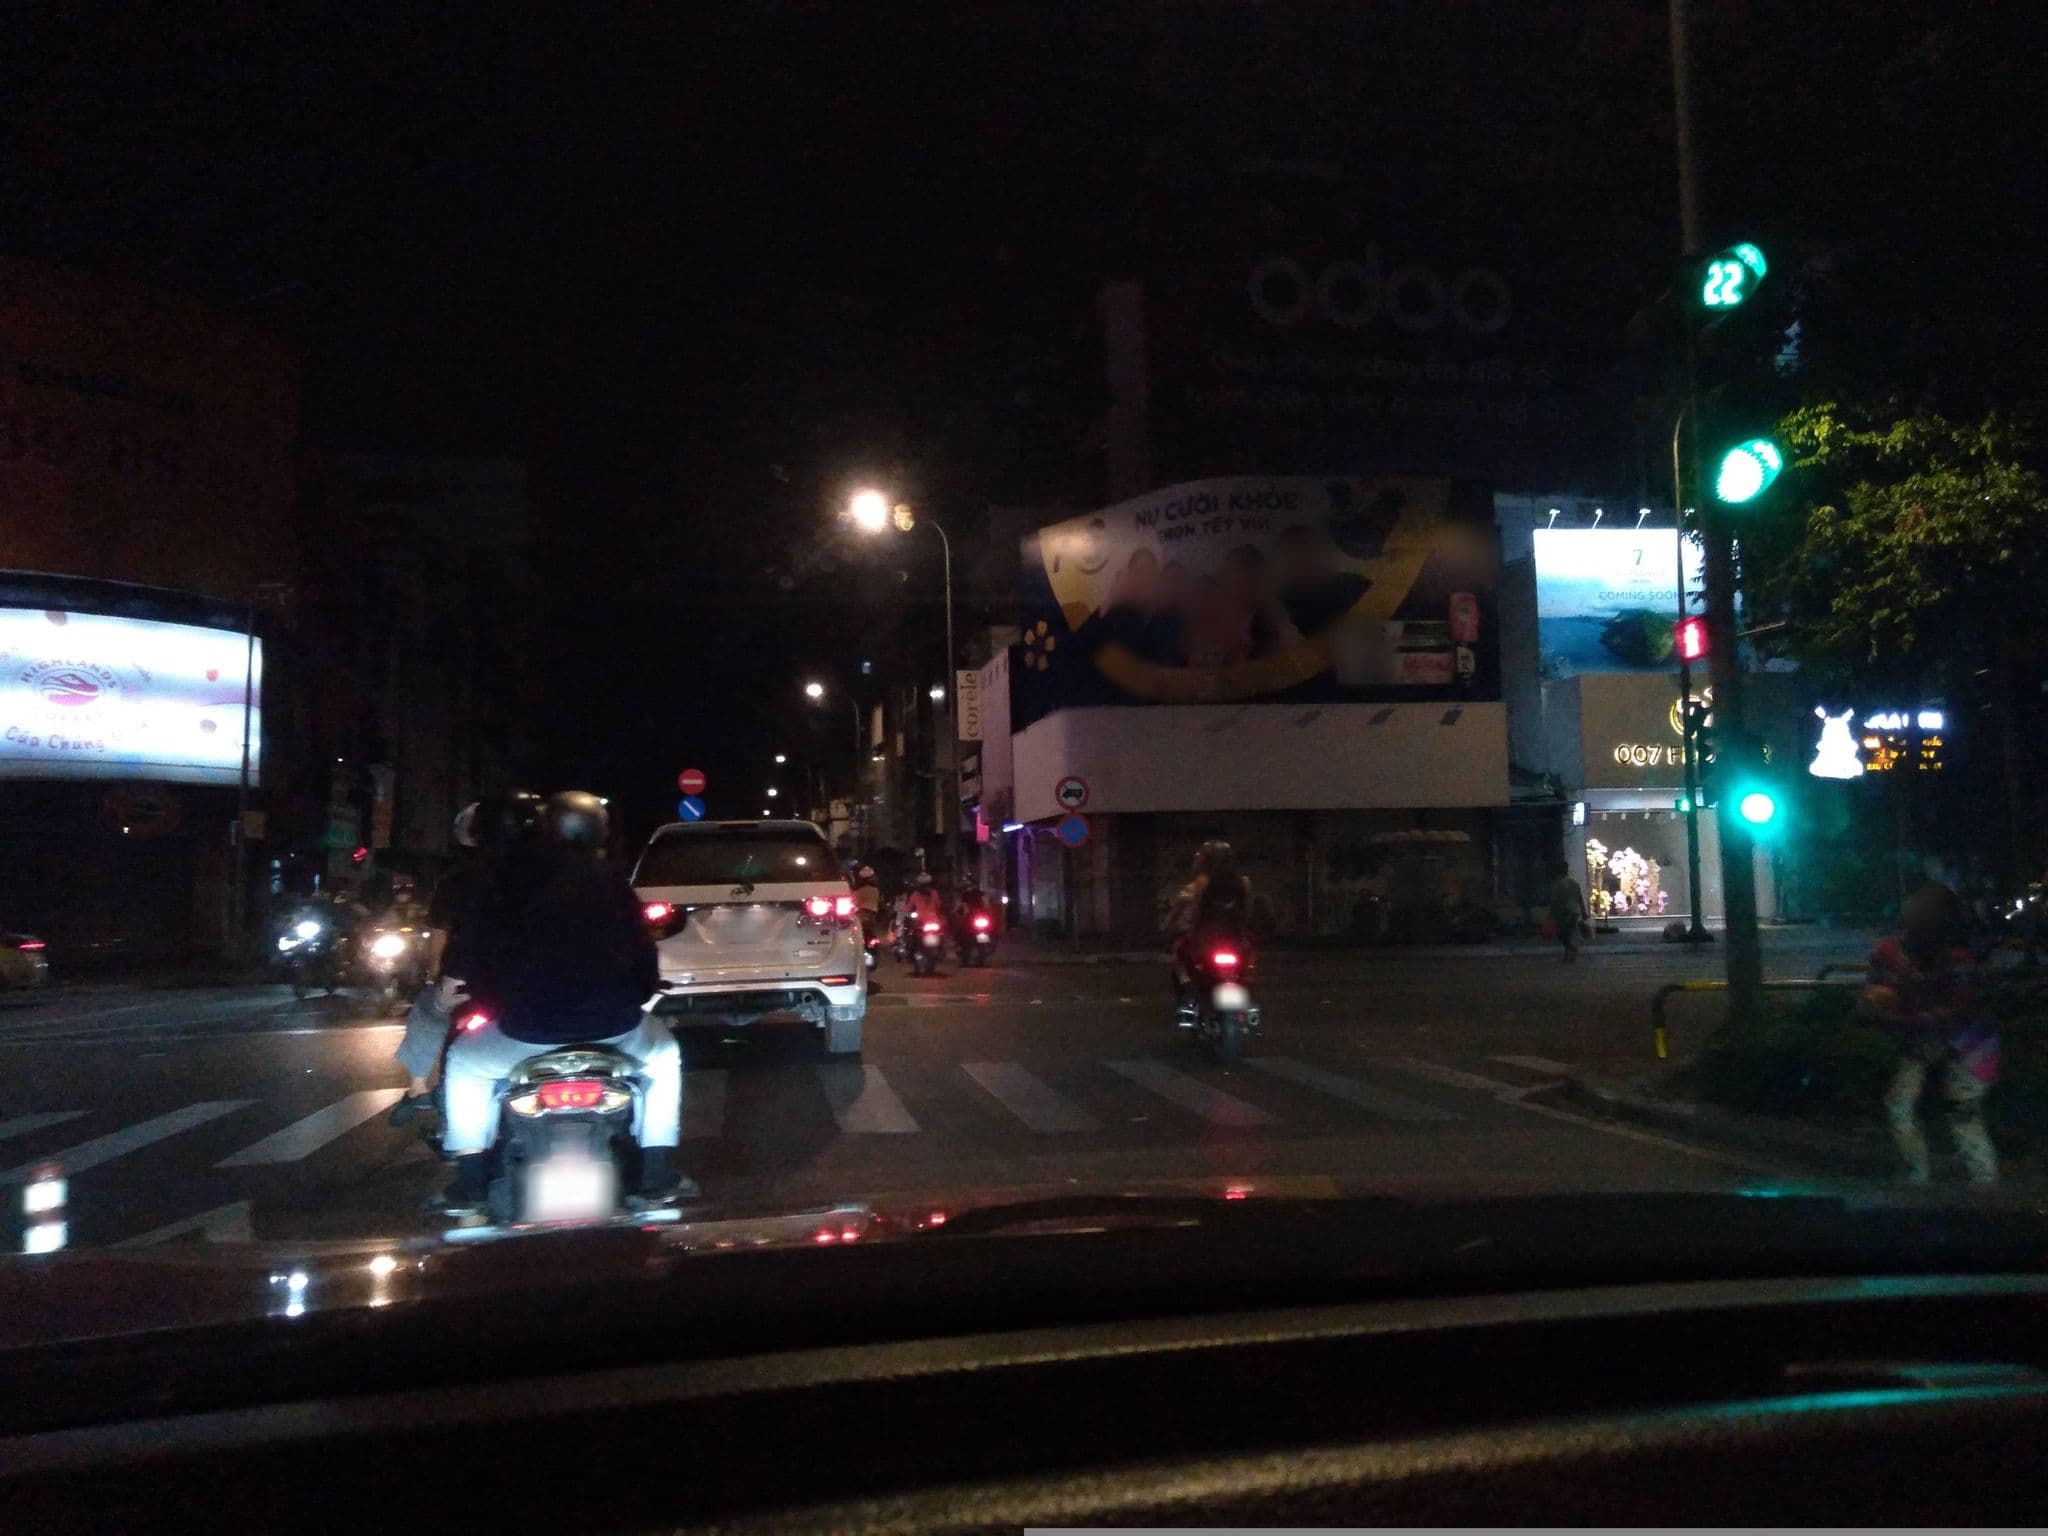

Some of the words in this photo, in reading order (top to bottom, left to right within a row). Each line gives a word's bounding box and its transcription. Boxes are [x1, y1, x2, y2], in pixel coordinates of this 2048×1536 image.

[1247, 243, 1512, 333] odoo
[1703, 260, 1744, 306] 22
[1632, 549, 1644, 567] 7
[1598, 591, 1645, 601] COMING
[20, 659, 118, 689] HIGHLANDS
[1614, 744, 1662, 766] 007
